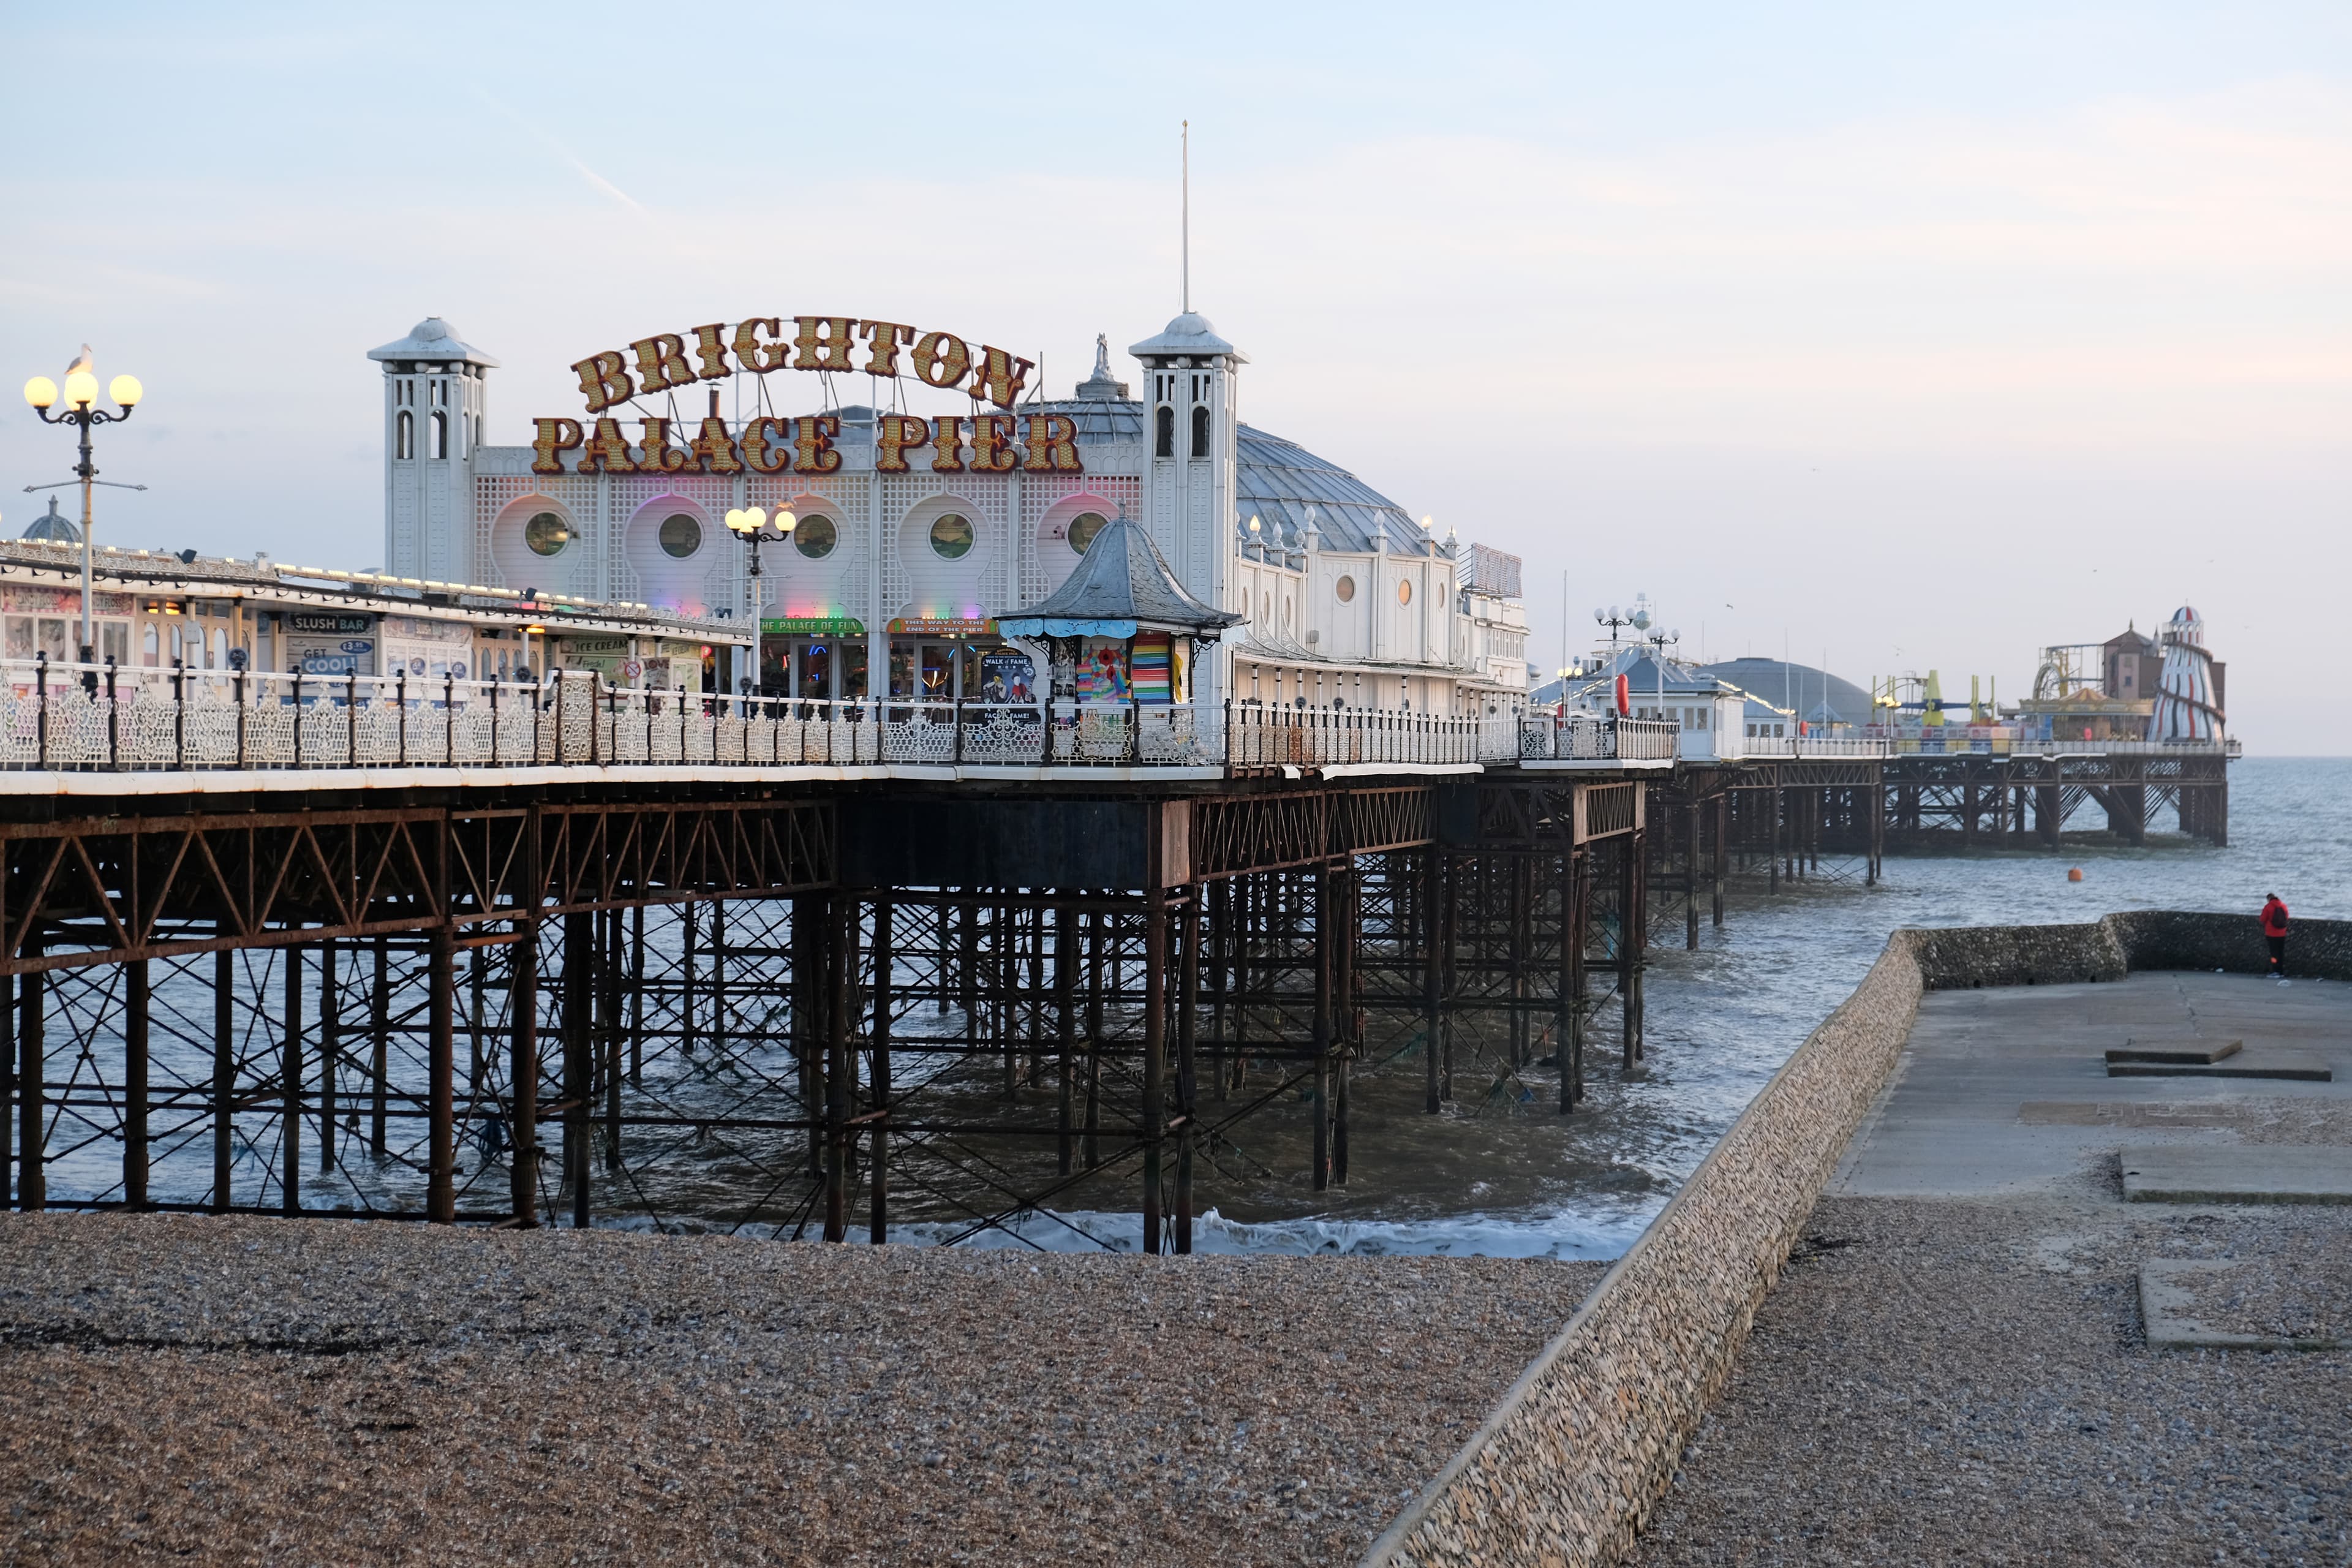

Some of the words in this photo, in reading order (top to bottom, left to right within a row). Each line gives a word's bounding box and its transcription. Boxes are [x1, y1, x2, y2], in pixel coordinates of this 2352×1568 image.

[570, 315, 1036, 415] BRIGHTON
[532, 417, 842, 475] PALACE
[876, 415, 1085, 474] PIER
[39, 594, 58, 606] FLOSS
[104, 596, 123, 608] FLOSS
[295, 617, 335, 629] SLUSH
[339, 619, 364, 630] BAR
[779, 621, 816, 630] PALACE
[821, 621, 833, 630] OF
[838, 621, 858, 630] FUN
[576, 643, 592, 652] ICE
[595, 641, 628, 651] CREAM
[304, 649, 326, 658] GET
[305, 657, 355, 673] COOL!
